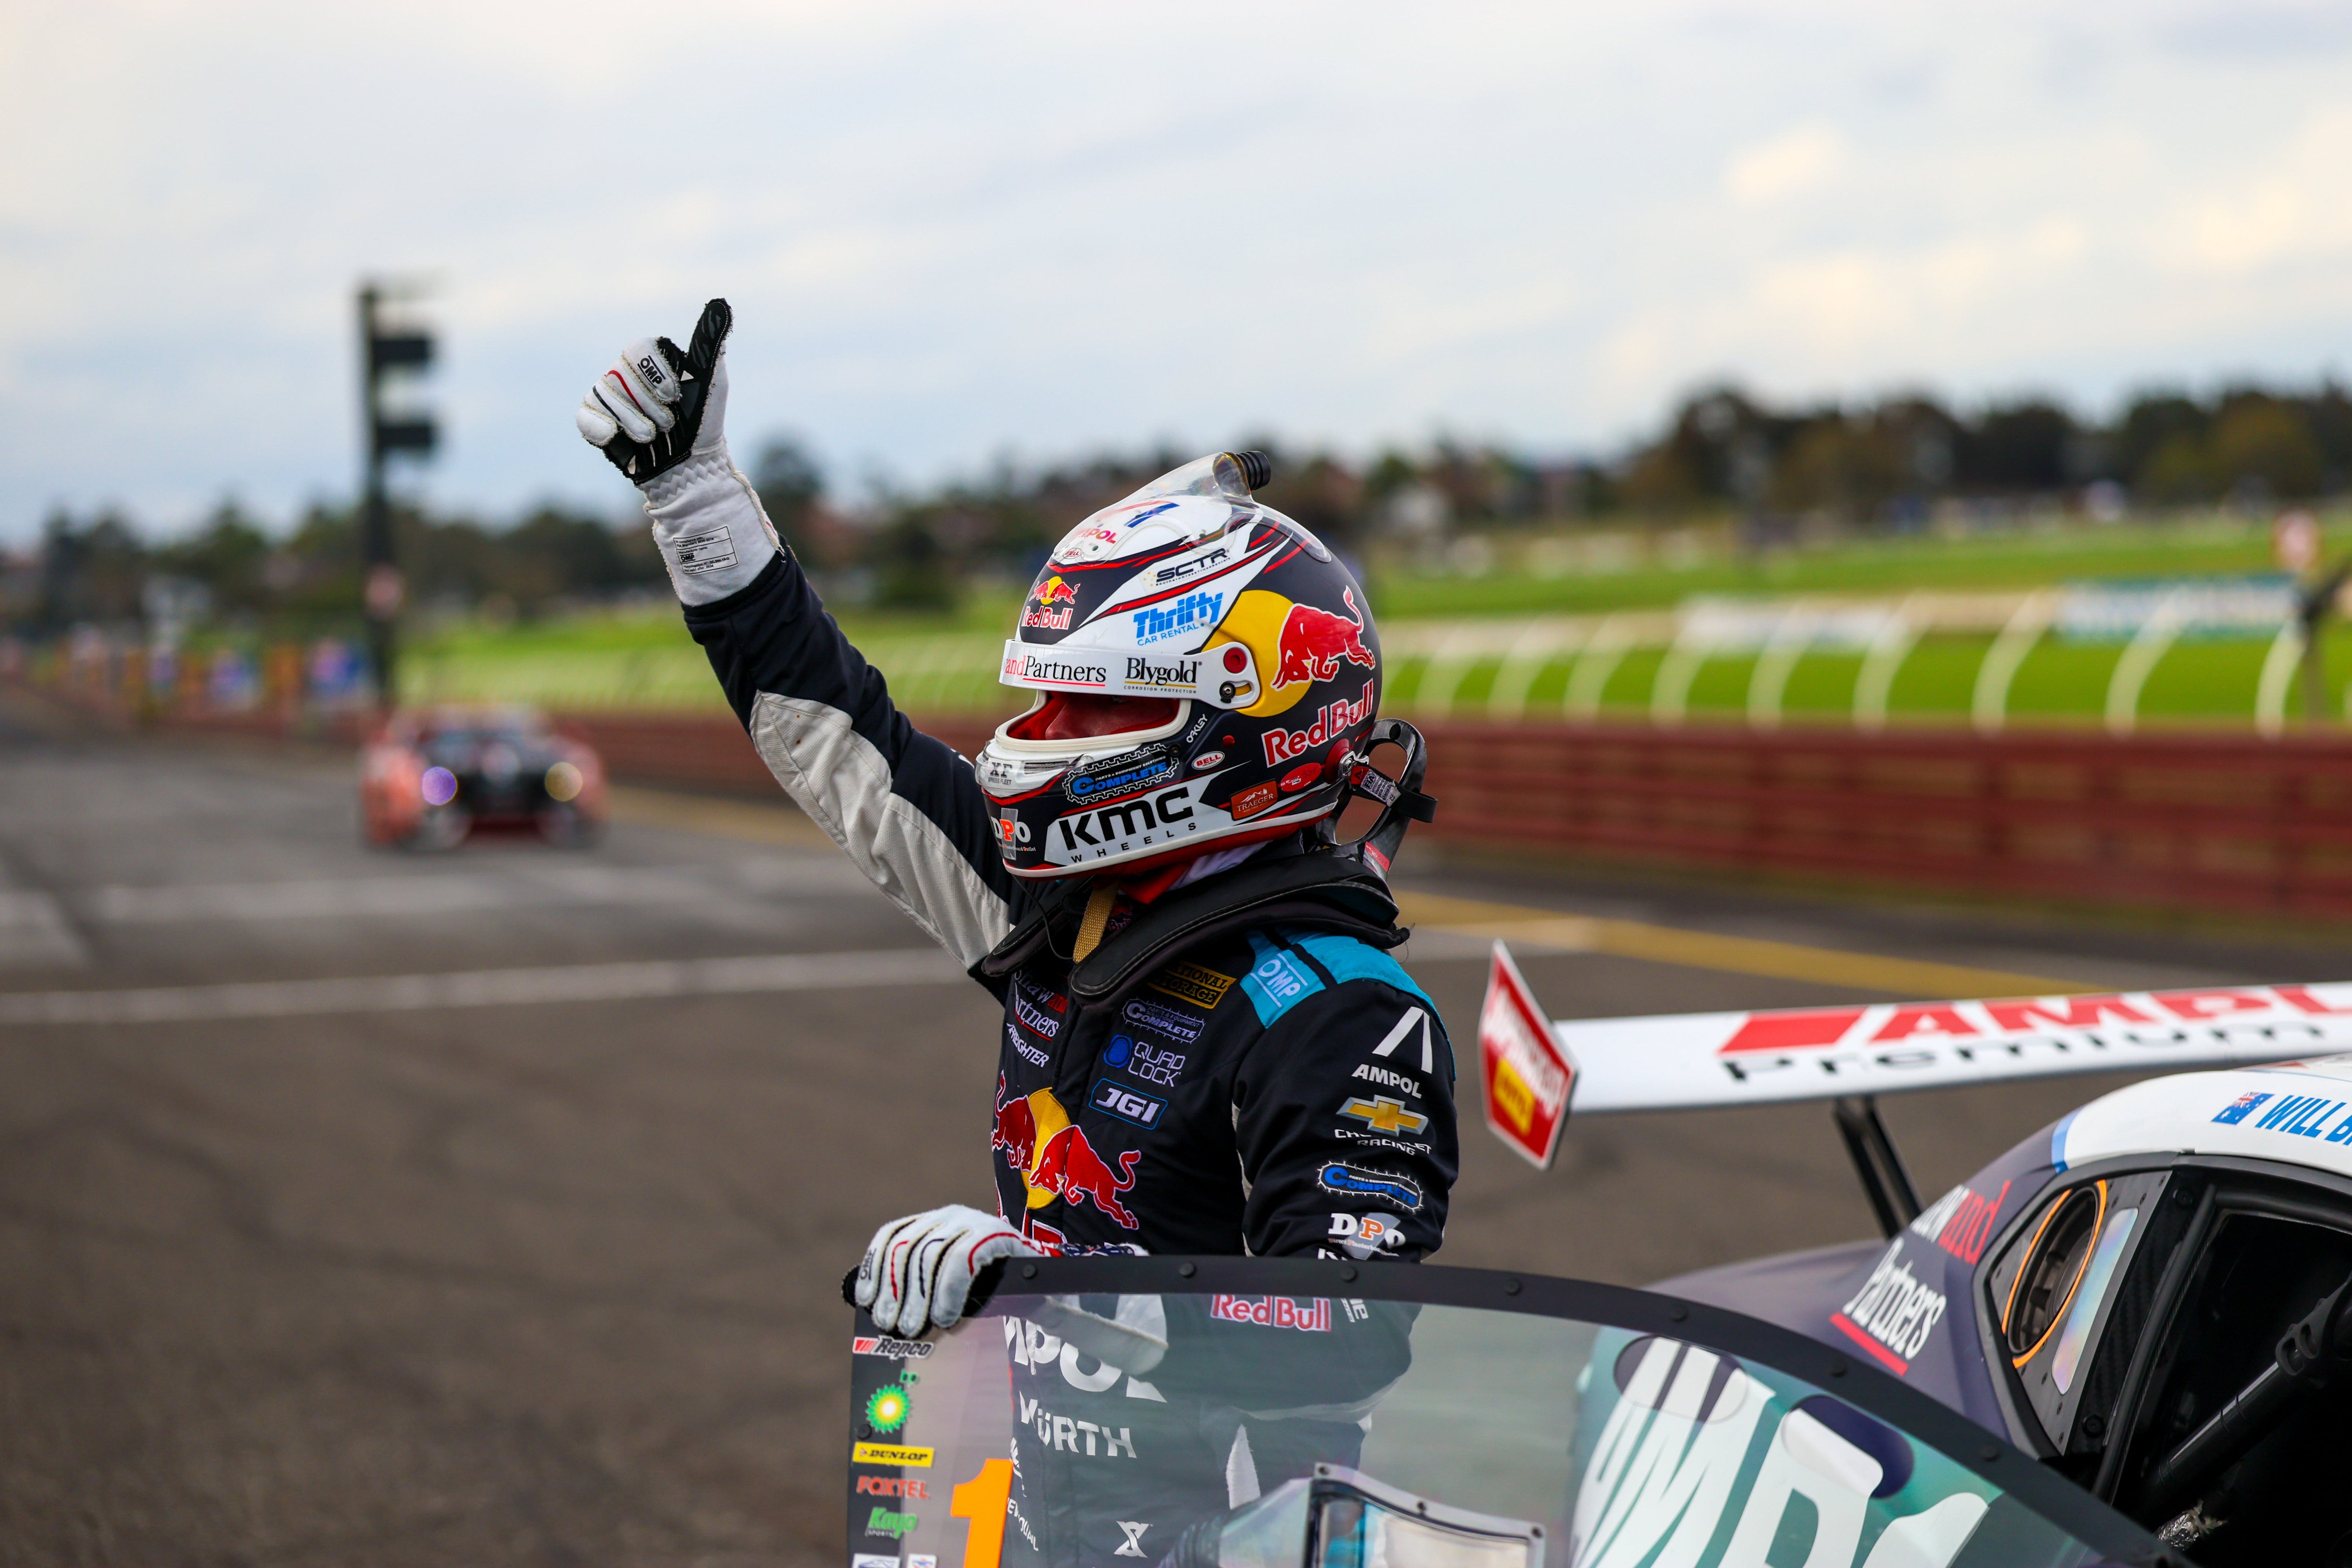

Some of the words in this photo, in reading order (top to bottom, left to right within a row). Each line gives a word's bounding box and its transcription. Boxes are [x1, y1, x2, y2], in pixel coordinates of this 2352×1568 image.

[639, 358, 662, 385] OMP
[1156, 548, 1227, 583] SCTR
[1021, 606, 1044, 627] Red
[1040, 607, 1074, 630] Bull
[1133, 592, 1223, 639] Thrifty
[1137, 636, 1158, 646] CAR
[1160, 624, 1198, 642] RENTAL
[1186, 714, 1207, 743] OAKLEY
[1263, 707, 1327, 768] Red
[1330, 678, 1374, 737] Bull
[1115, 765, 1142, 775] EQUIPMENT
[1143, 756, 1166, 767] SOLUTIONS
[1196, 754, 1221, 766] BELL
[1236, 793, 1274, 812] TRAEGER
[991, 816, 1031, 843] DPO
[1071, 822, 1196, 863] WHEELS
[1154, 975, 1216, 1002] TORAGE
[1258, 959, 1301, 998] OMP
[1134, 1041, 1185, 1071] QUAD
[1128, 1061, 1178, 1087] LOCK
[1351, 1063, 1422, 1099] AMPOL
[1096, 1087, 1159, 1123] JGI
[2254, 1095, 2348, 1138] WILL
[1357, 1138, 1416, 1156] RACING
[1328, 1213, 1406, 1249] DPO
[1211, 1294, 1272, 1325] Red
[1274, 1298, 1331, 1332] Bull
[875, 1336, 933, 1358] Repco
[900, 1369, 918, 1385] bp
[869, 1449, 928, 1461] DUNLOP
[857, 1475, 929, 1499] FOXTEL
[869, 1506, 918, 1539] Kayo
[951, 1458, 1013, 1568] 1
